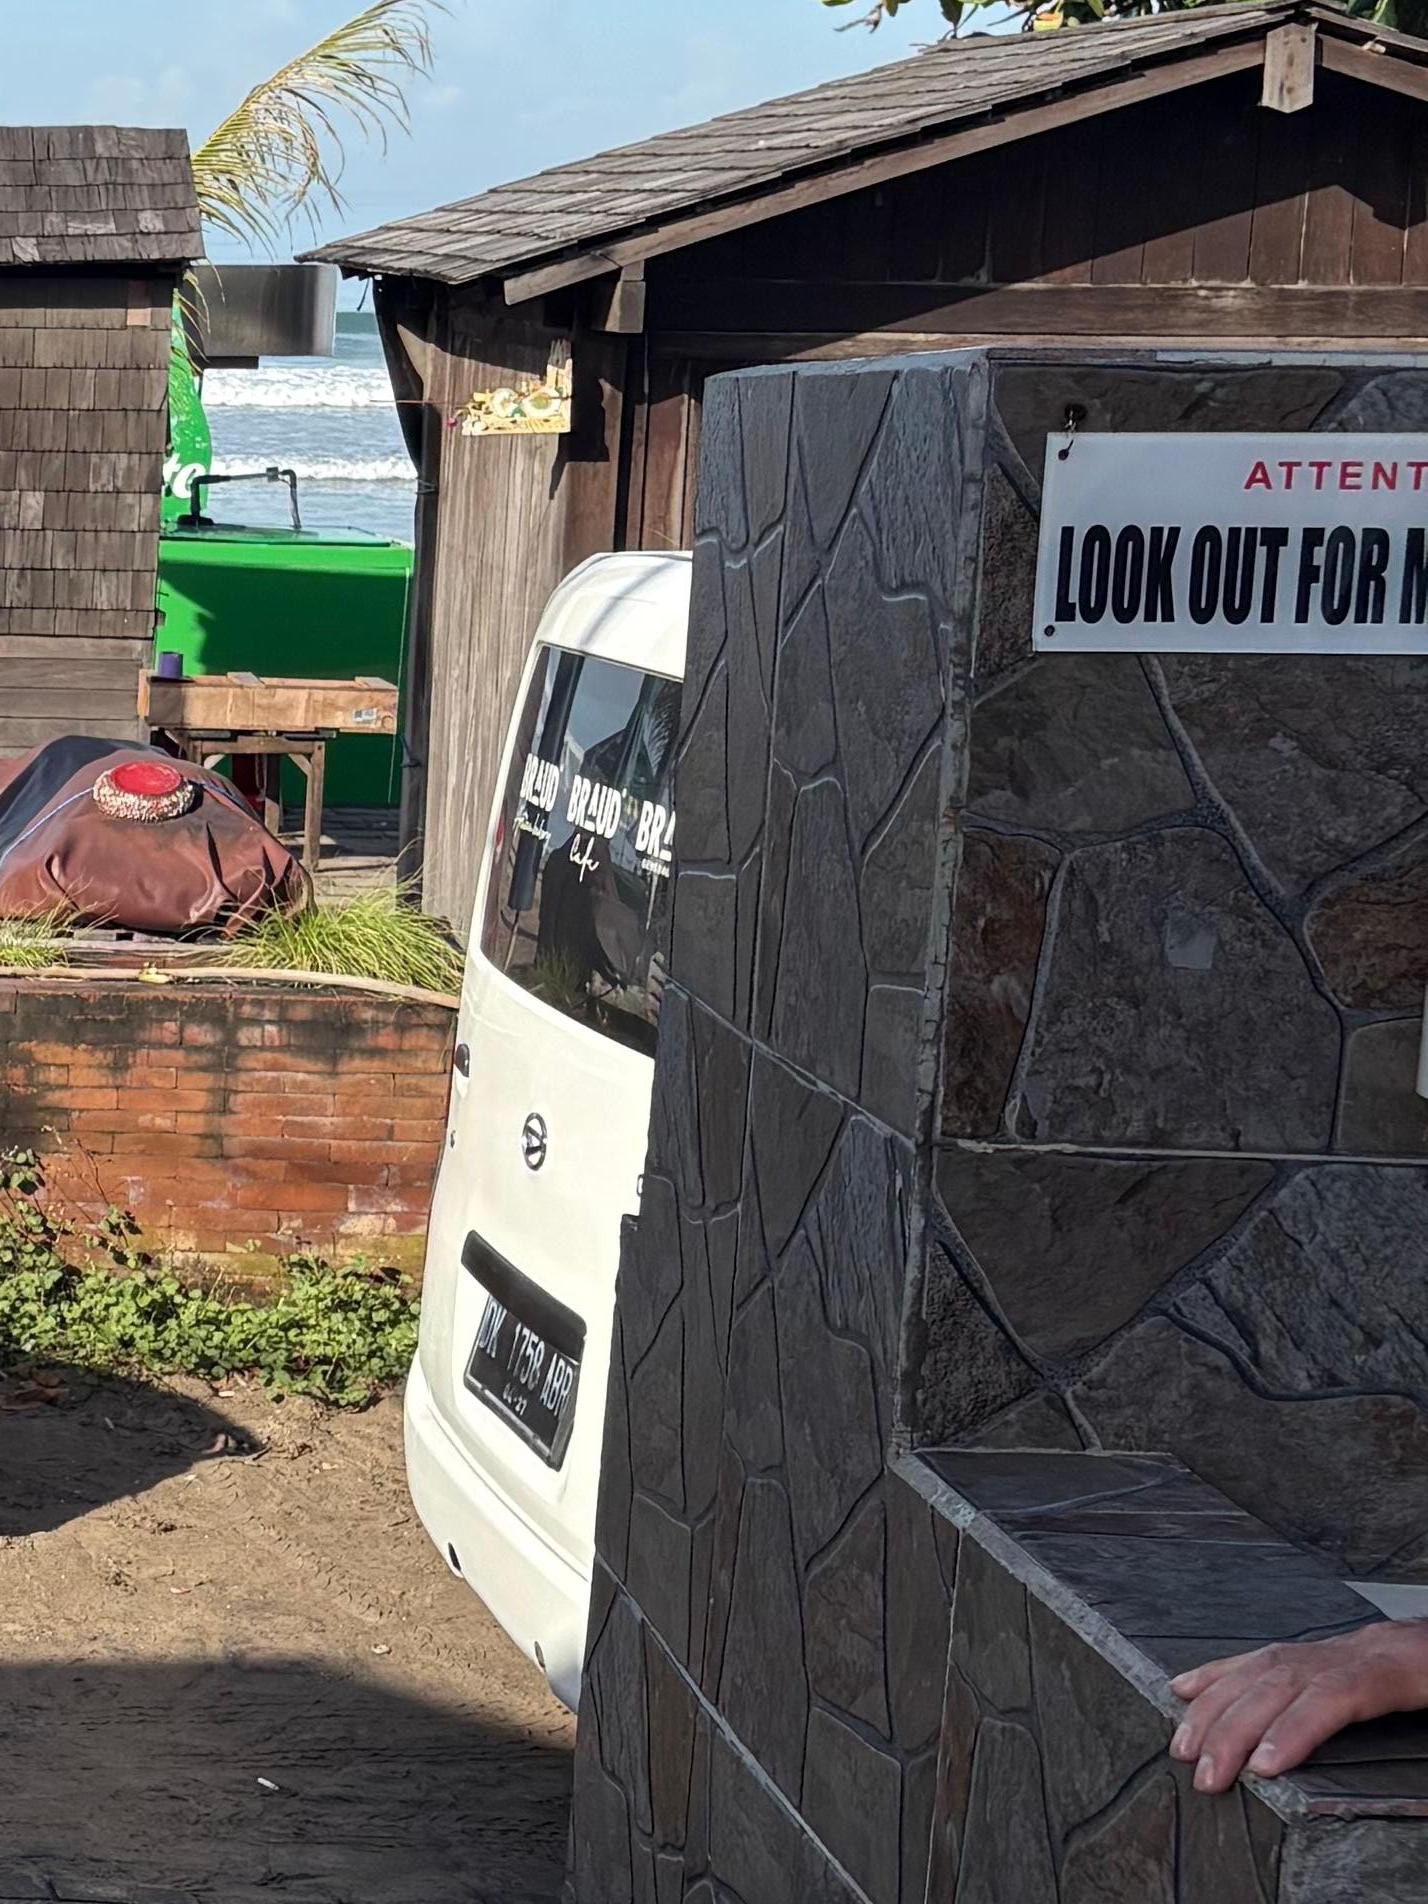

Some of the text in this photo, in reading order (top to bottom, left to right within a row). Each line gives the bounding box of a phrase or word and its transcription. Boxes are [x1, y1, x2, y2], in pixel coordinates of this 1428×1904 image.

[1244, 460, 1428, 491] ATTENT
[1055, 524, 1182, 625] LOOK
[1188, 524, 1289, 626] OUT
[1294, 524, 1391, 626] FOR
